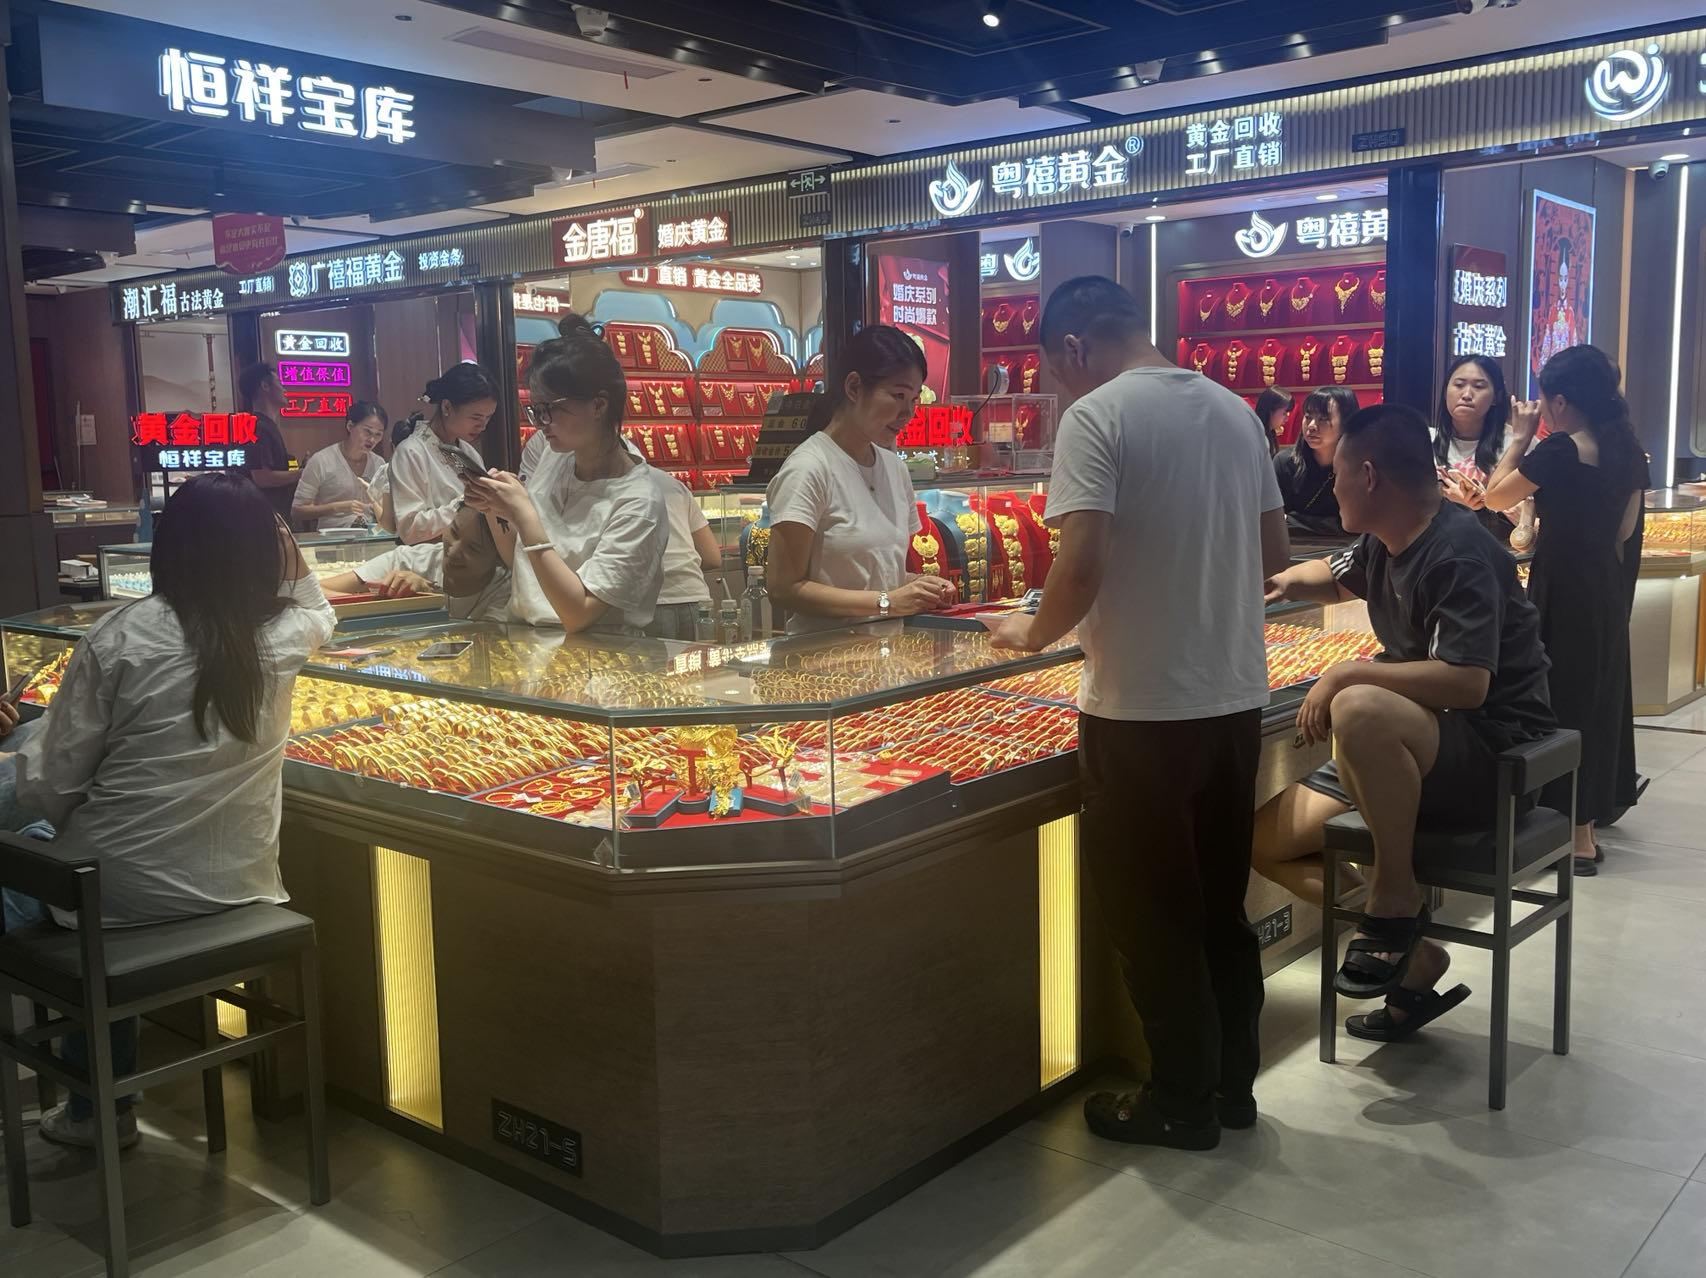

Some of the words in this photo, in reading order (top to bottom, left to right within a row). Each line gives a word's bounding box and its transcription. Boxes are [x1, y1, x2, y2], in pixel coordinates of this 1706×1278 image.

[158, 47, 417, 145] 恒祥宝库
[1186, 112, 1283, 149] 黄金回收
[1186, 140, 1283, 176] 工厂直销
[562, 216, 638, 263] 金唐福
[657, 216, 728, 249] 婚庆黄金
[311, 250, 405, 293] 广禧福黄金
[123, 282, 177, 320] 潮汇福
[179, 288, 224, 314] 古法黄金
[893, 283, 937, 305] 婚庆系列
[282, 335, 345, 351] 黄金回收
[285, 366, 346, 382] 增值保值
[286, 396, 347, 413] 工厂直销
[135, 411, 259, 447] 黄金回收
[158, 449, 246, 468] 恒祥宝库
[1256, 911, 1290, 945] H21-3
